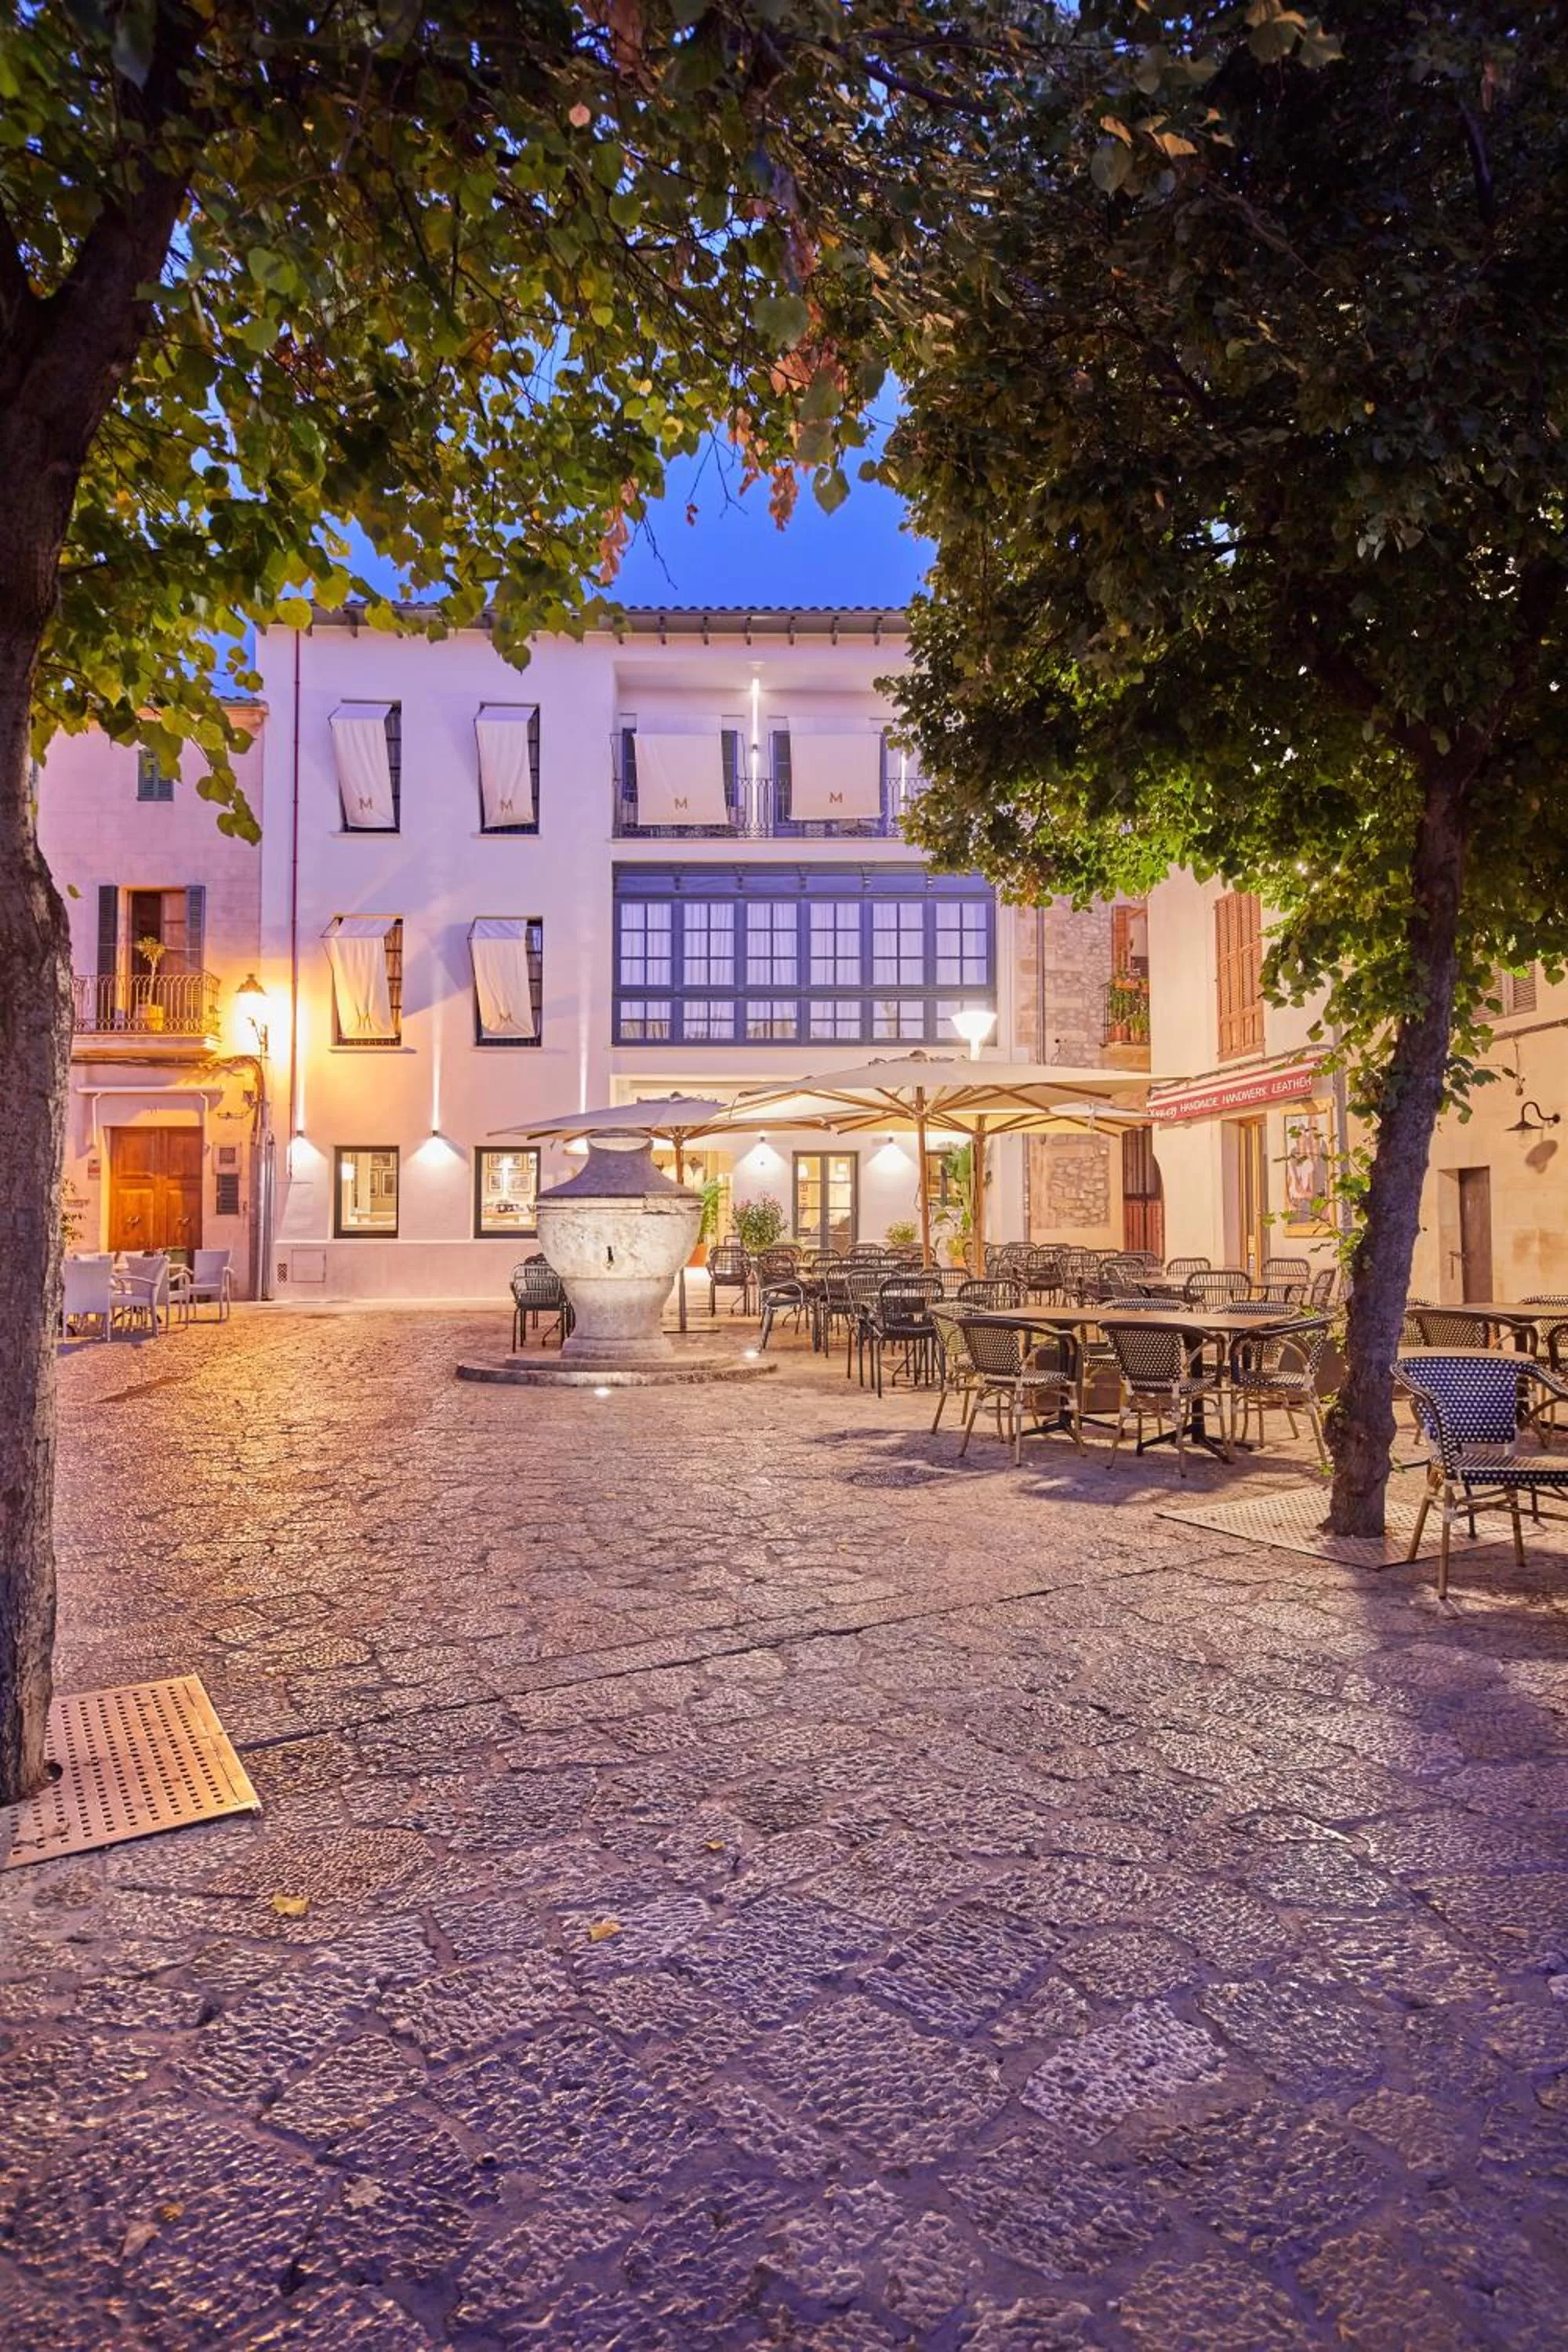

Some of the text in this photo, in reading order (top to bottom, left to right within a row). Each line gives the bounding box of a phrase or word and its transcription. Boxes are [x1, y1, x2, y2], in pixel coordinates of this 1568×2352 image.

[358, 797, 372, 809] M
[674, 797, 688, 809] M
[829, 792, 843, 803] M
[500, 798, 514, 811] M
[499, 1012, 514, 1023] M
